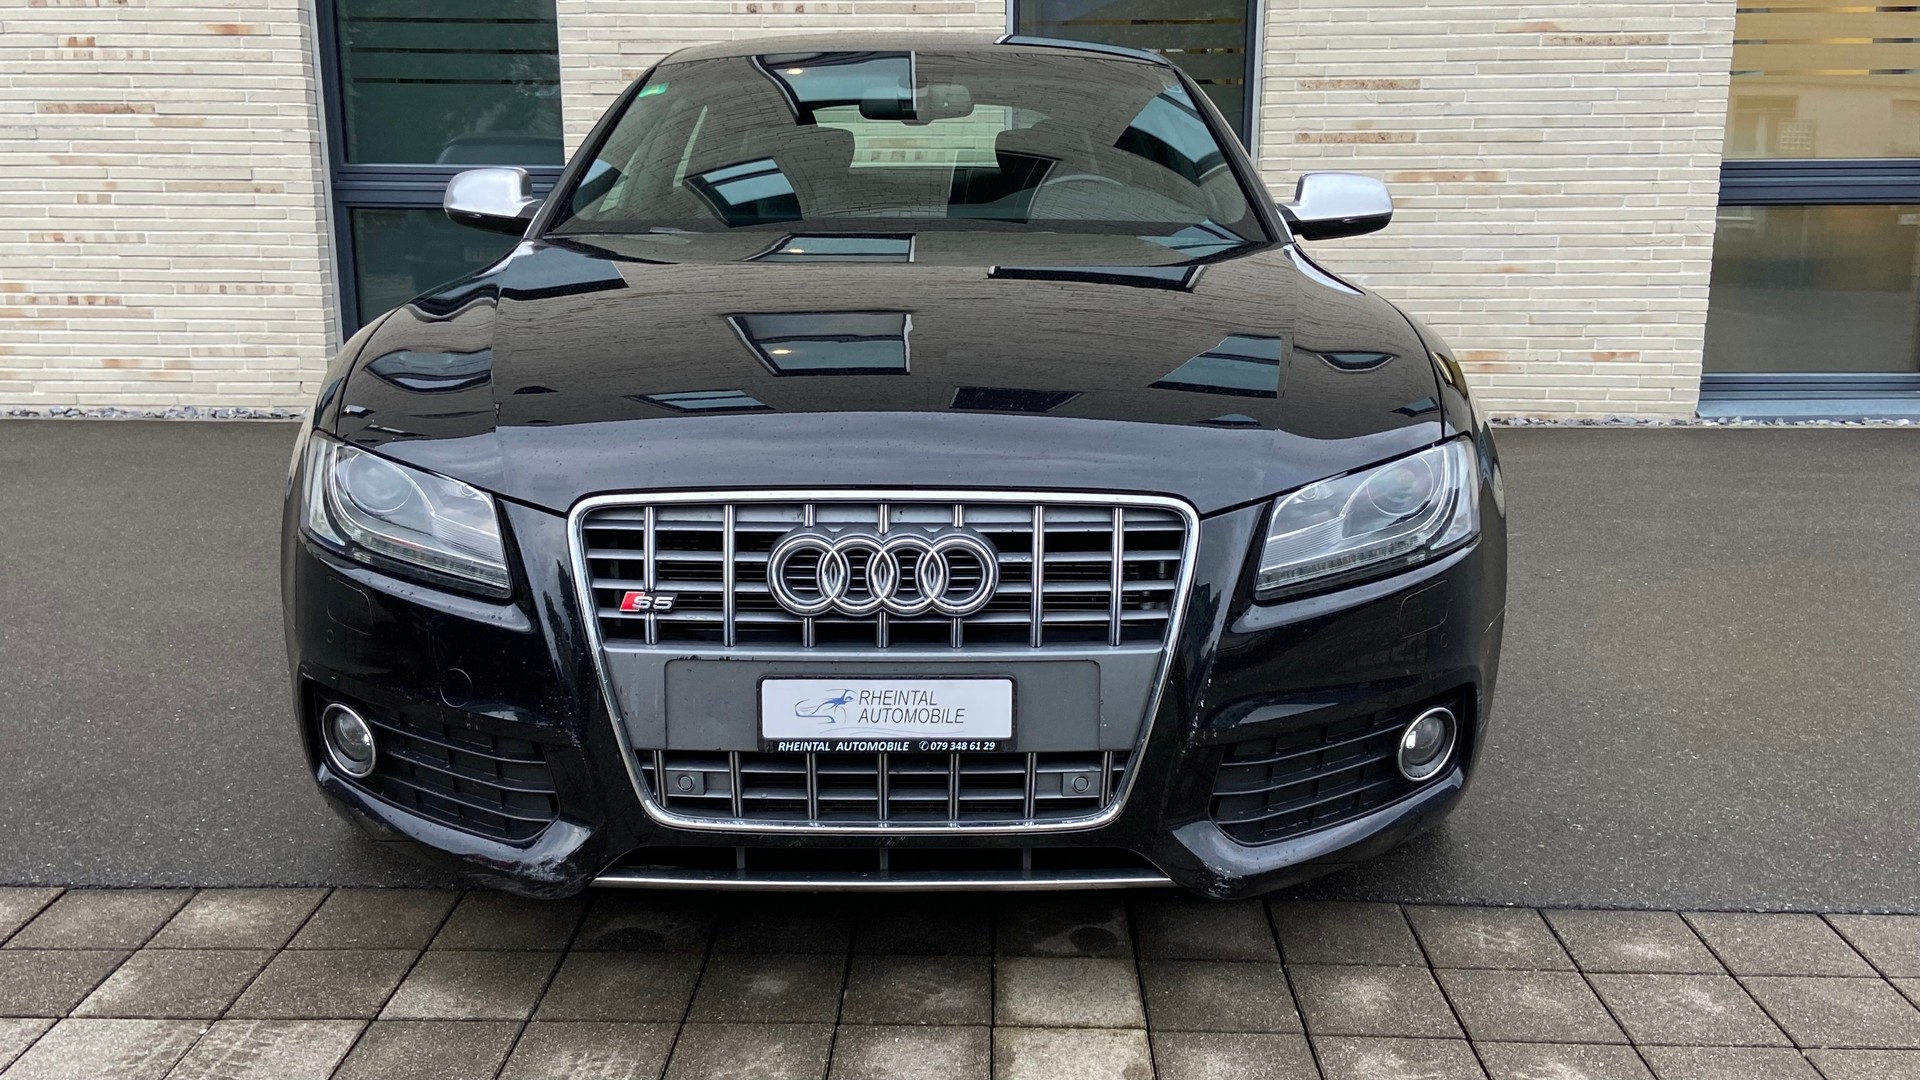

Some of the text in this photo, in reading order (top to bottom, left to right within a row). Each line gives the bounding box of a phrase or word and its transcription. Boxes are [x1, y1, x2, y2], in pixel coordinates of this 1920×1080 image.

[631, 596, 674, 610] S5
[858, 690, 938, 706] RHEINTAL
[857, 707, 966, 724] AUTOMOBILE
[778, 741, 996, 751] RHEINTAL AUTOMOBILE 079 348 61 29
